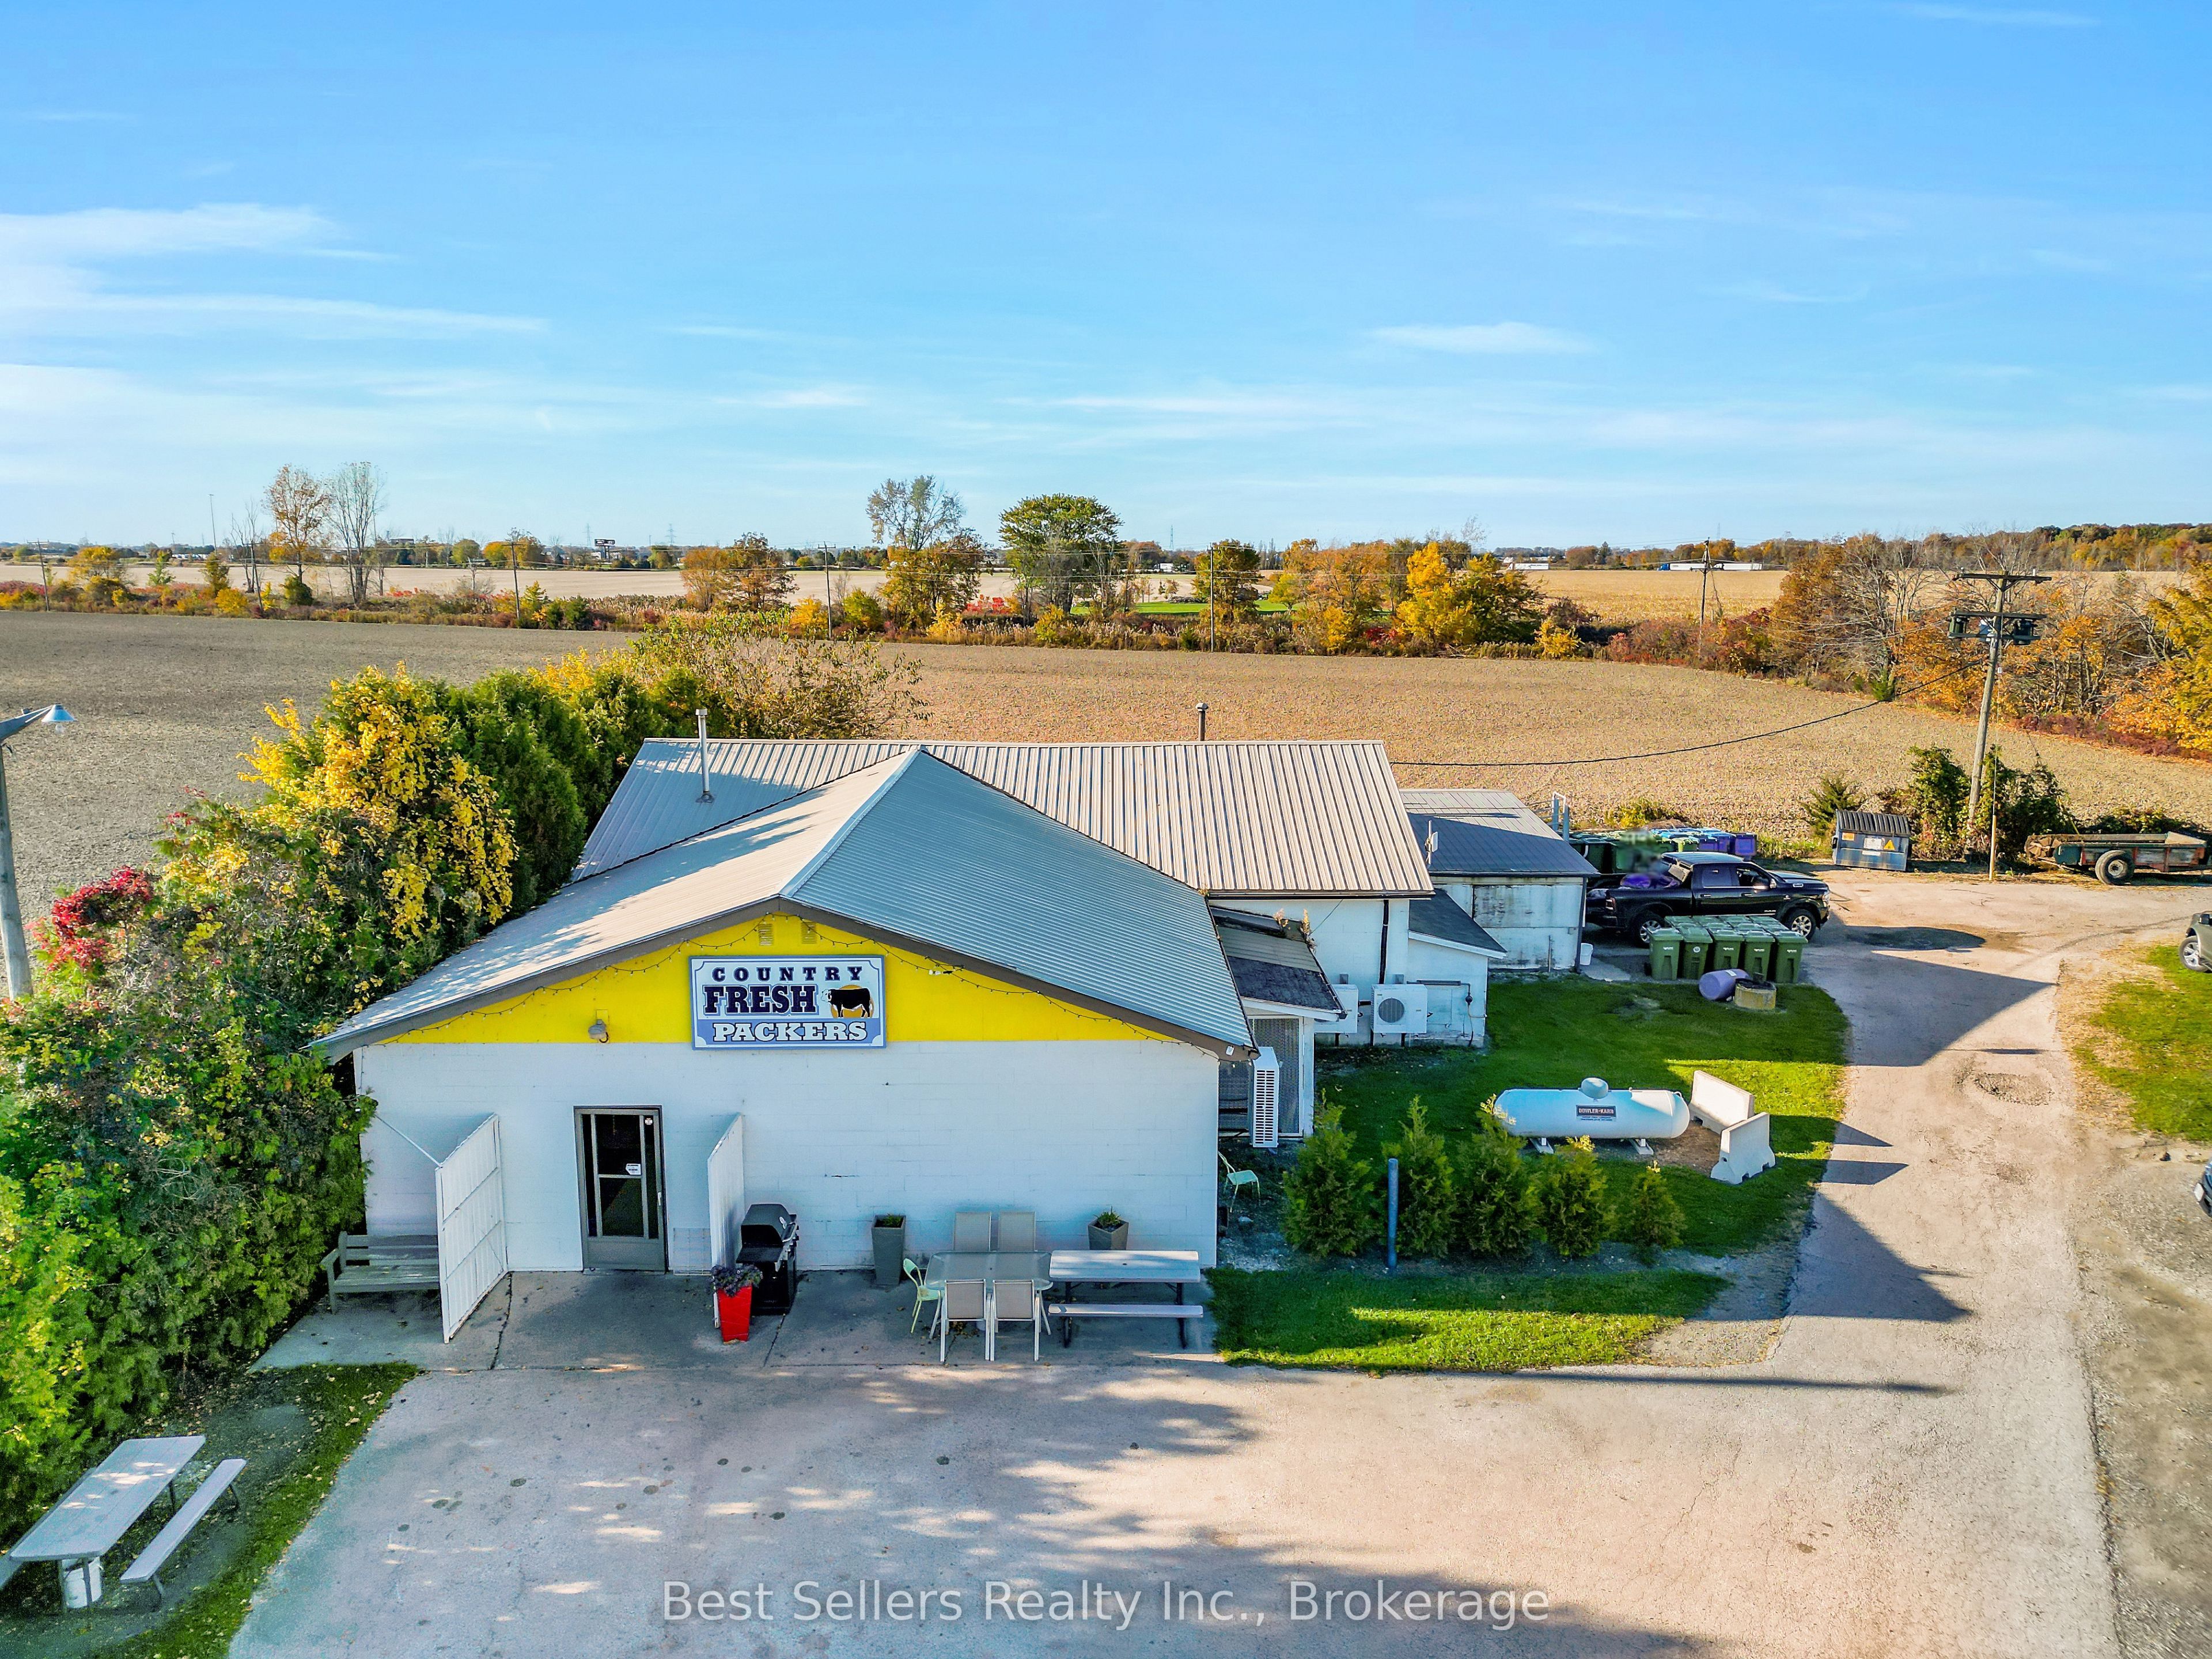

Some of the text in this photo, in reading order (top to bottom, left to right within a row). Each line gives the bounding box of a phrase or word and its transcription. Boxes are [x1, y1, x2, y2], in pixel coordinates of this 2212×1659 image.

[711, 966, 862, 982] COUNTRY
[703, 985, 817, 1016] FRESH
[713, 1021, 868, 1042] PACKERS
